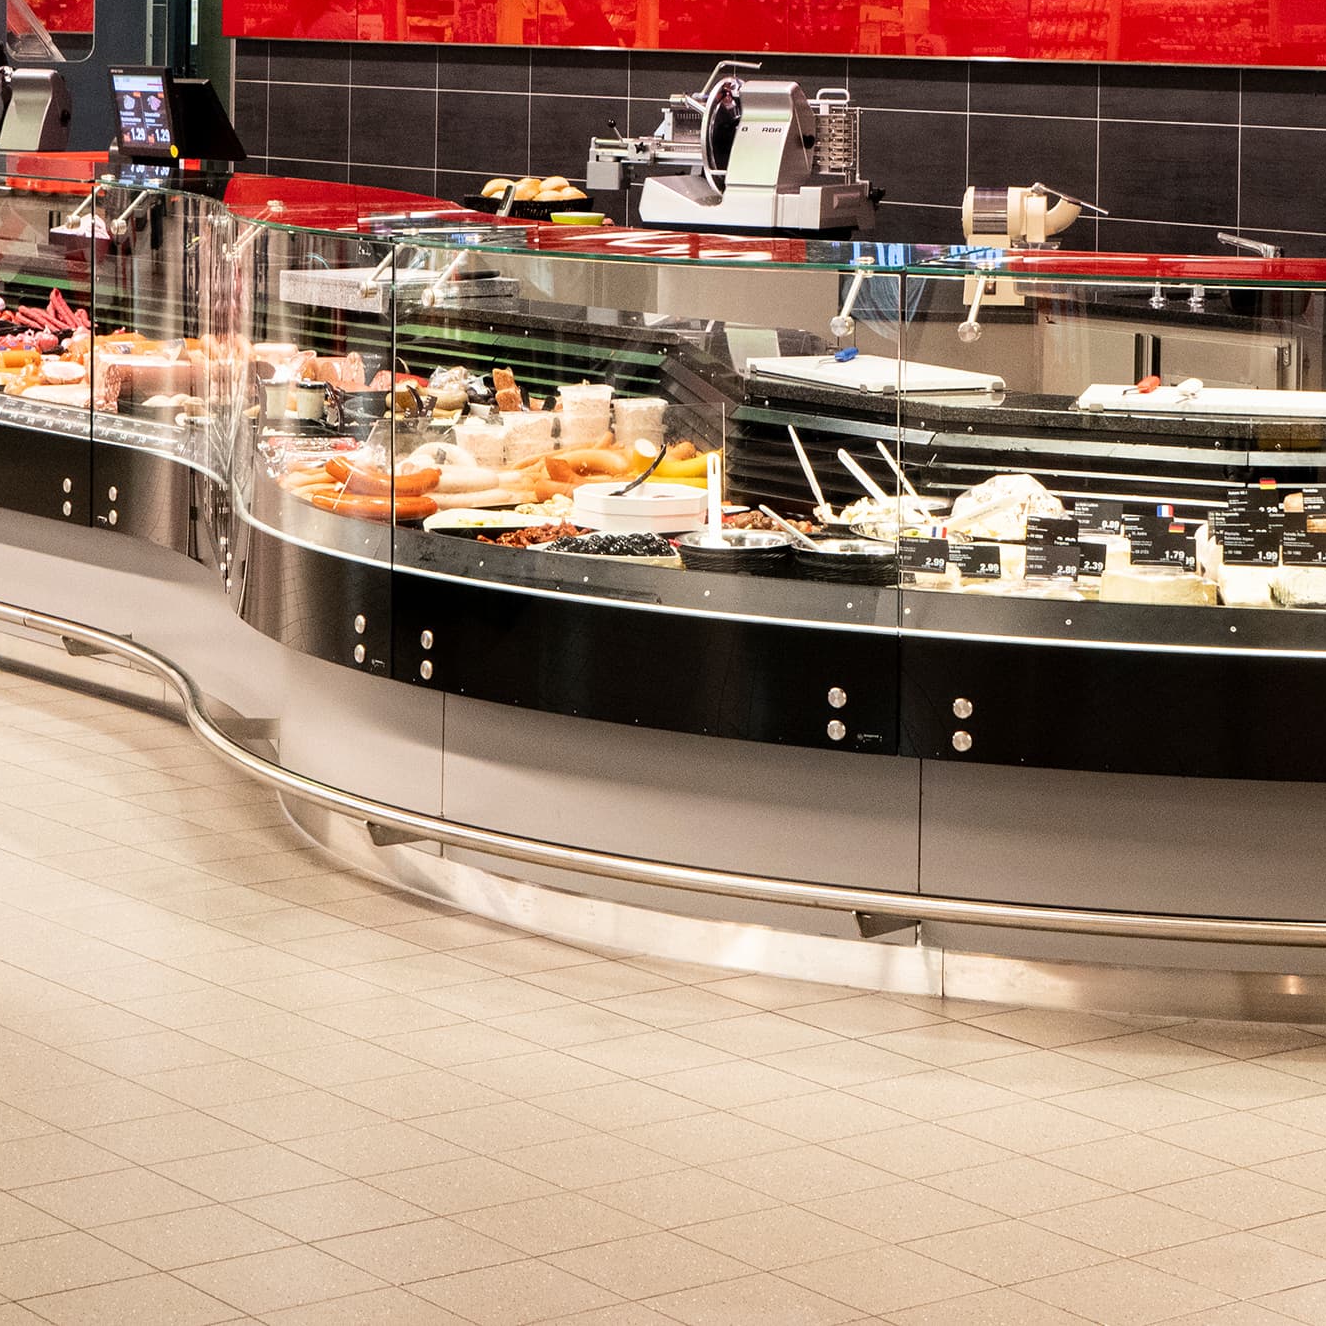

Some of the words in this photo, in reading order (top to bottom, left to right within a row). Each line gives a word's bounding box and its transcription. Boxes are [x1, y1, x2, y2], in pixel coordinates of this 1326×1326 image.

[1164, 550, 1186, 560] 1.79
[925, 557, 945, 567] 2.99
[1084, 560, 1104, 570] 2.39
